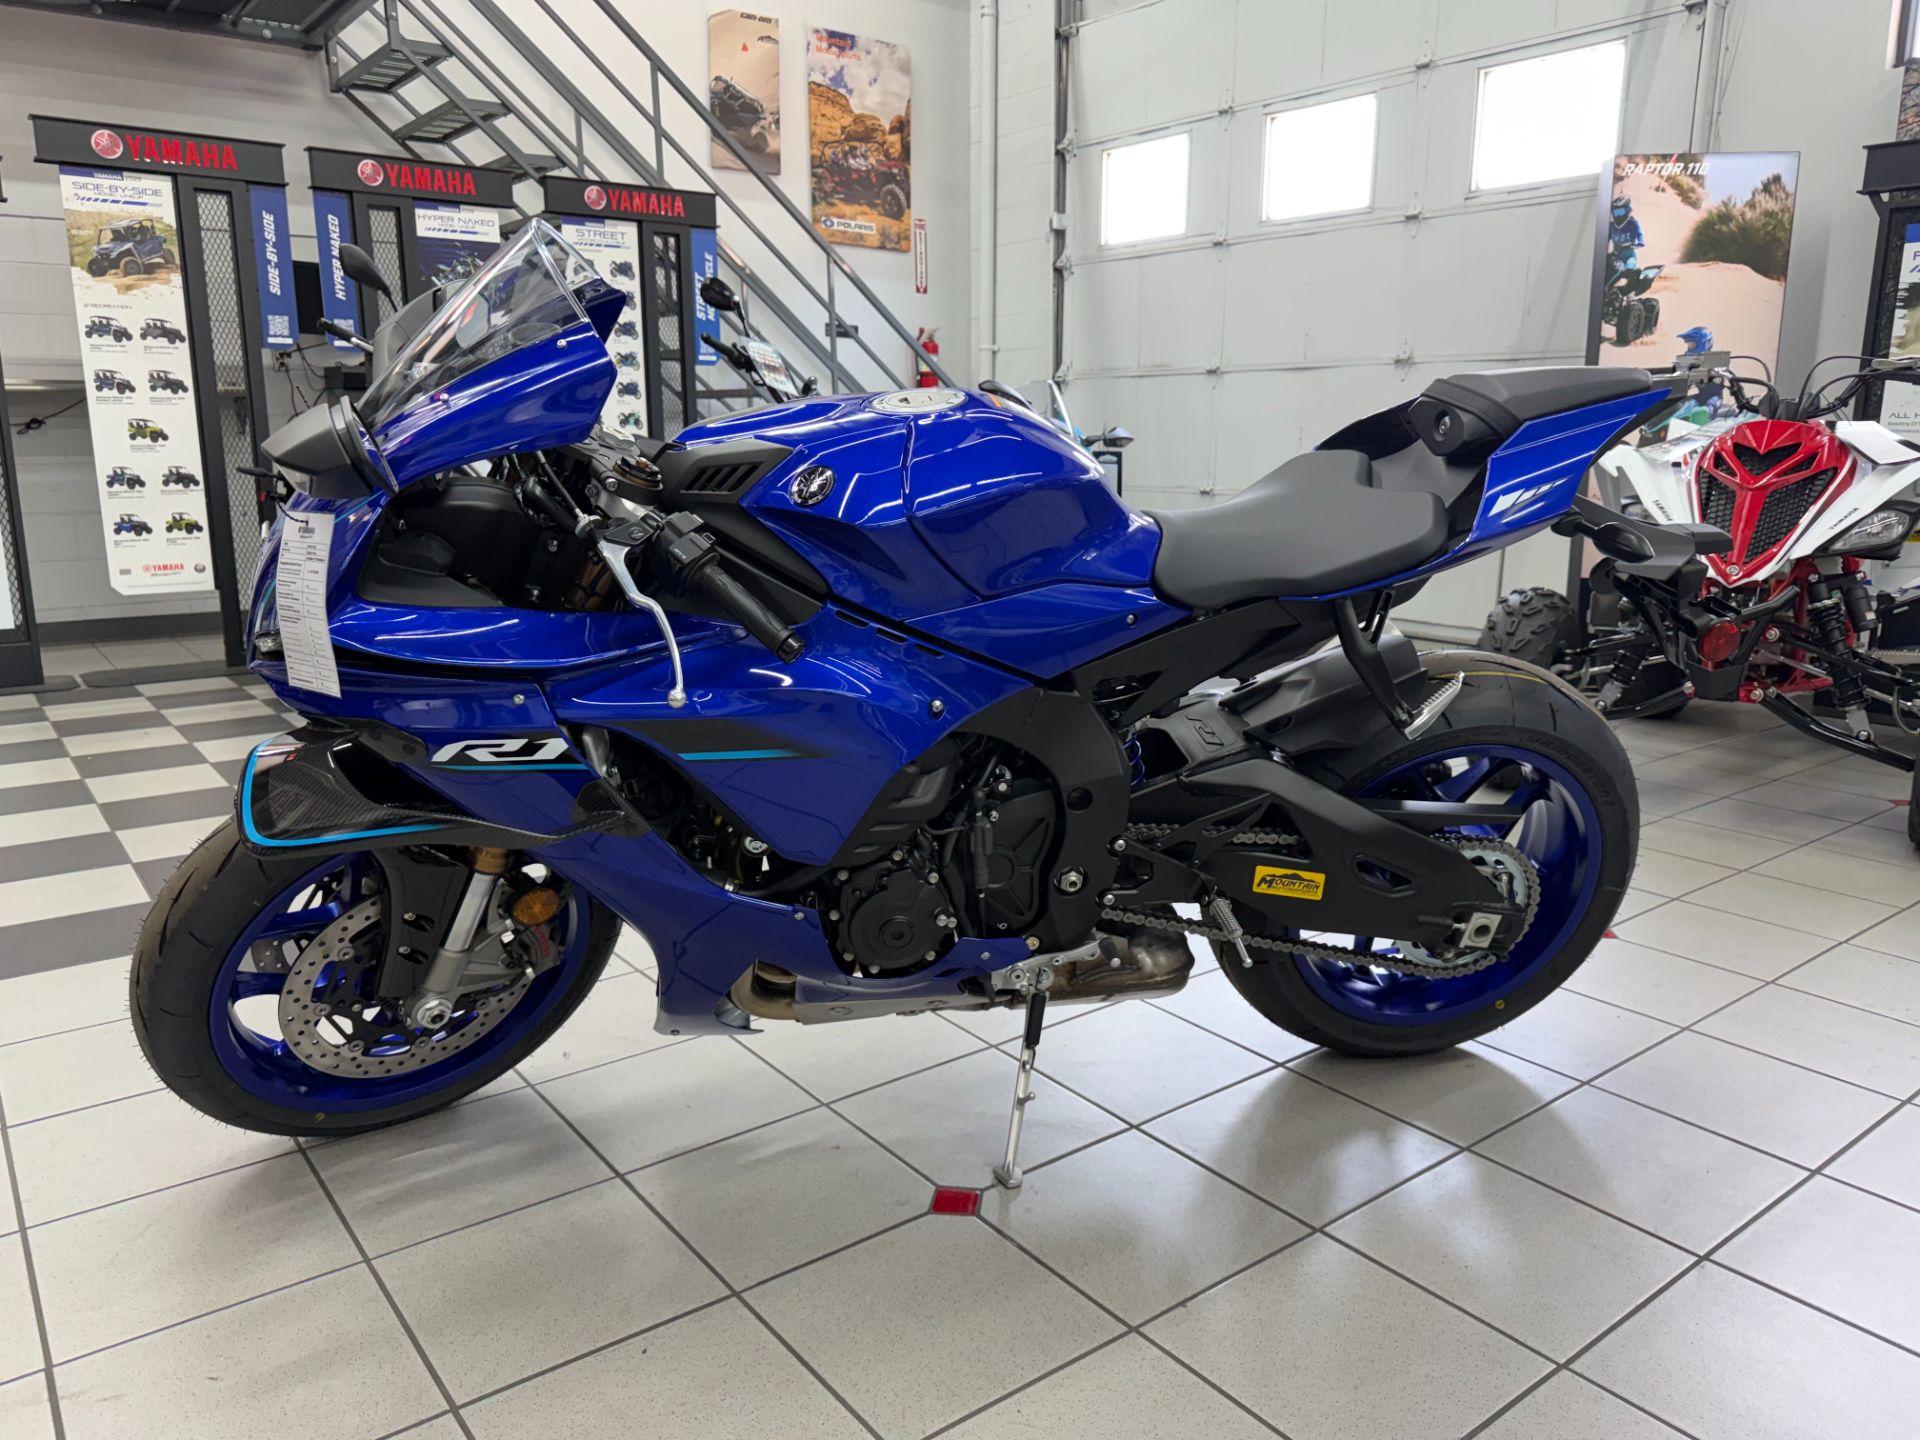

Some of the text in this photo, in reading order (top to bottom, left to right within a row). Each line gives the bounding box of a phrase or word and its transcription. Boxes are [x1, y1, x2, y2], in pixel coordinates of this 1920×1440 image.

[125, 134, 238, 171] YAMAHA
[385, 163, 477, 195] YAMAHA
[1623, 162, 1711, 176] RAPTOR 110
[72, 181, 164, 197] SIDE-BY-SIDE
[608, 188, 686, 217] YAMAHA
[417, 213, 455, 224] HYPER
[458, 217, 495, 227] NAKED
[837, 221, 874, 232] POLARIS
[575, 229, 628, 240] STREET
[262, 210, 281, 296] SIDE-BY-SIDE
[327, 213, 346, 301] HYPER NAKED
[152, 563, 185, 572] YAMAHA
[431, 738, 569, 762] R1
